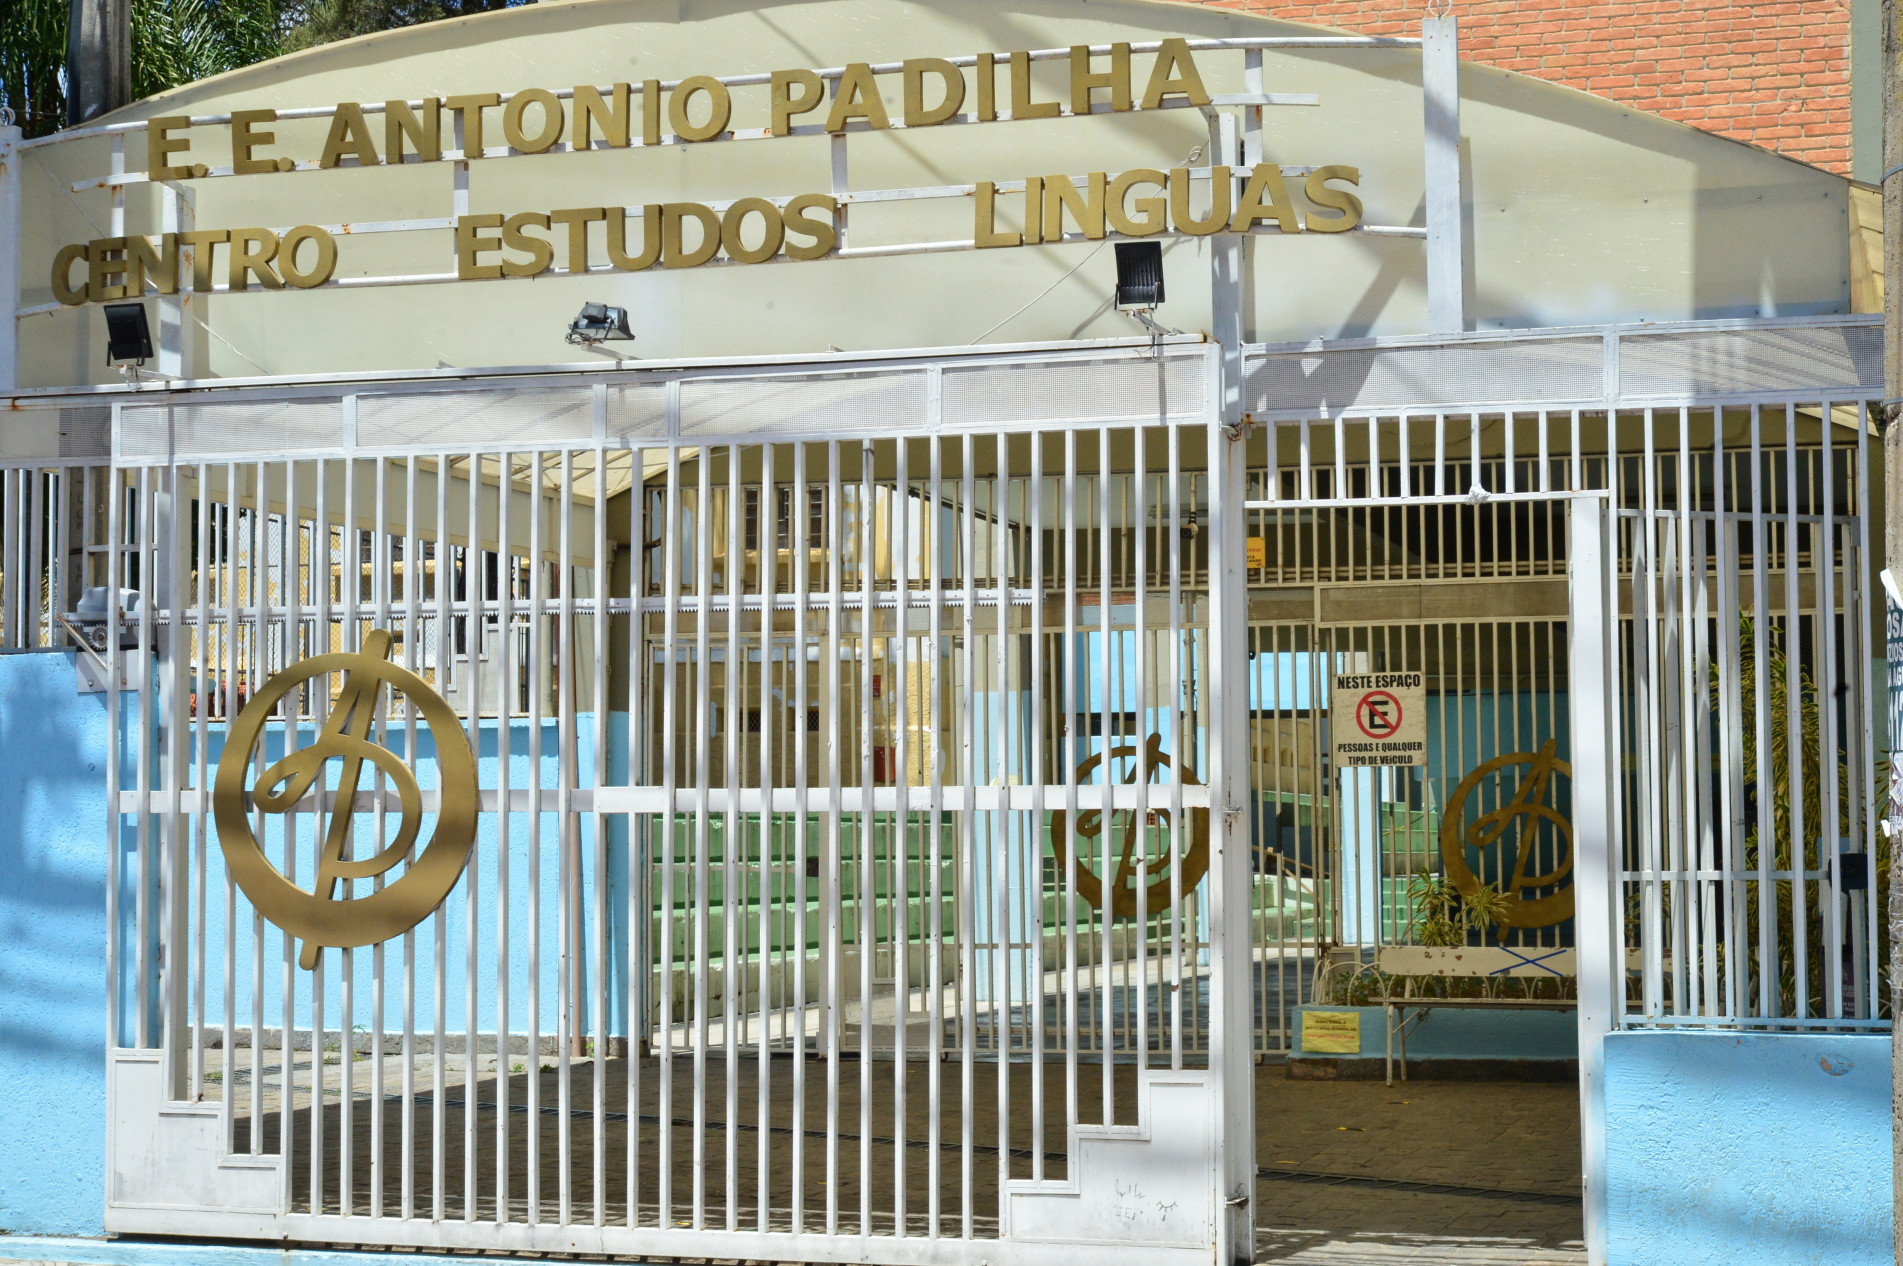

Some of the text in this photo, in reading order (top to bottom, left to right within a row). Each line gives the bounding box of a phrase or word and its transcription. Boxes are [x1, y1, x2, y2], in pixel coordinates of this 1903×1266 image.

[319, 75, 731, 169] ANTONIO
[770, 37, 1212, 136] PADILHA
[51, 162, 1363, 306] CENTRO ESTUDOS LINGUAS
[1337, 674, 1420, 690] NESTE ESPAÇO
[1338, 741, 1422, 752] PESSOAS E QUALQUER
[1348, 756, 1367, 765] TIPO
[1368, 756, 1378, 765] DE
